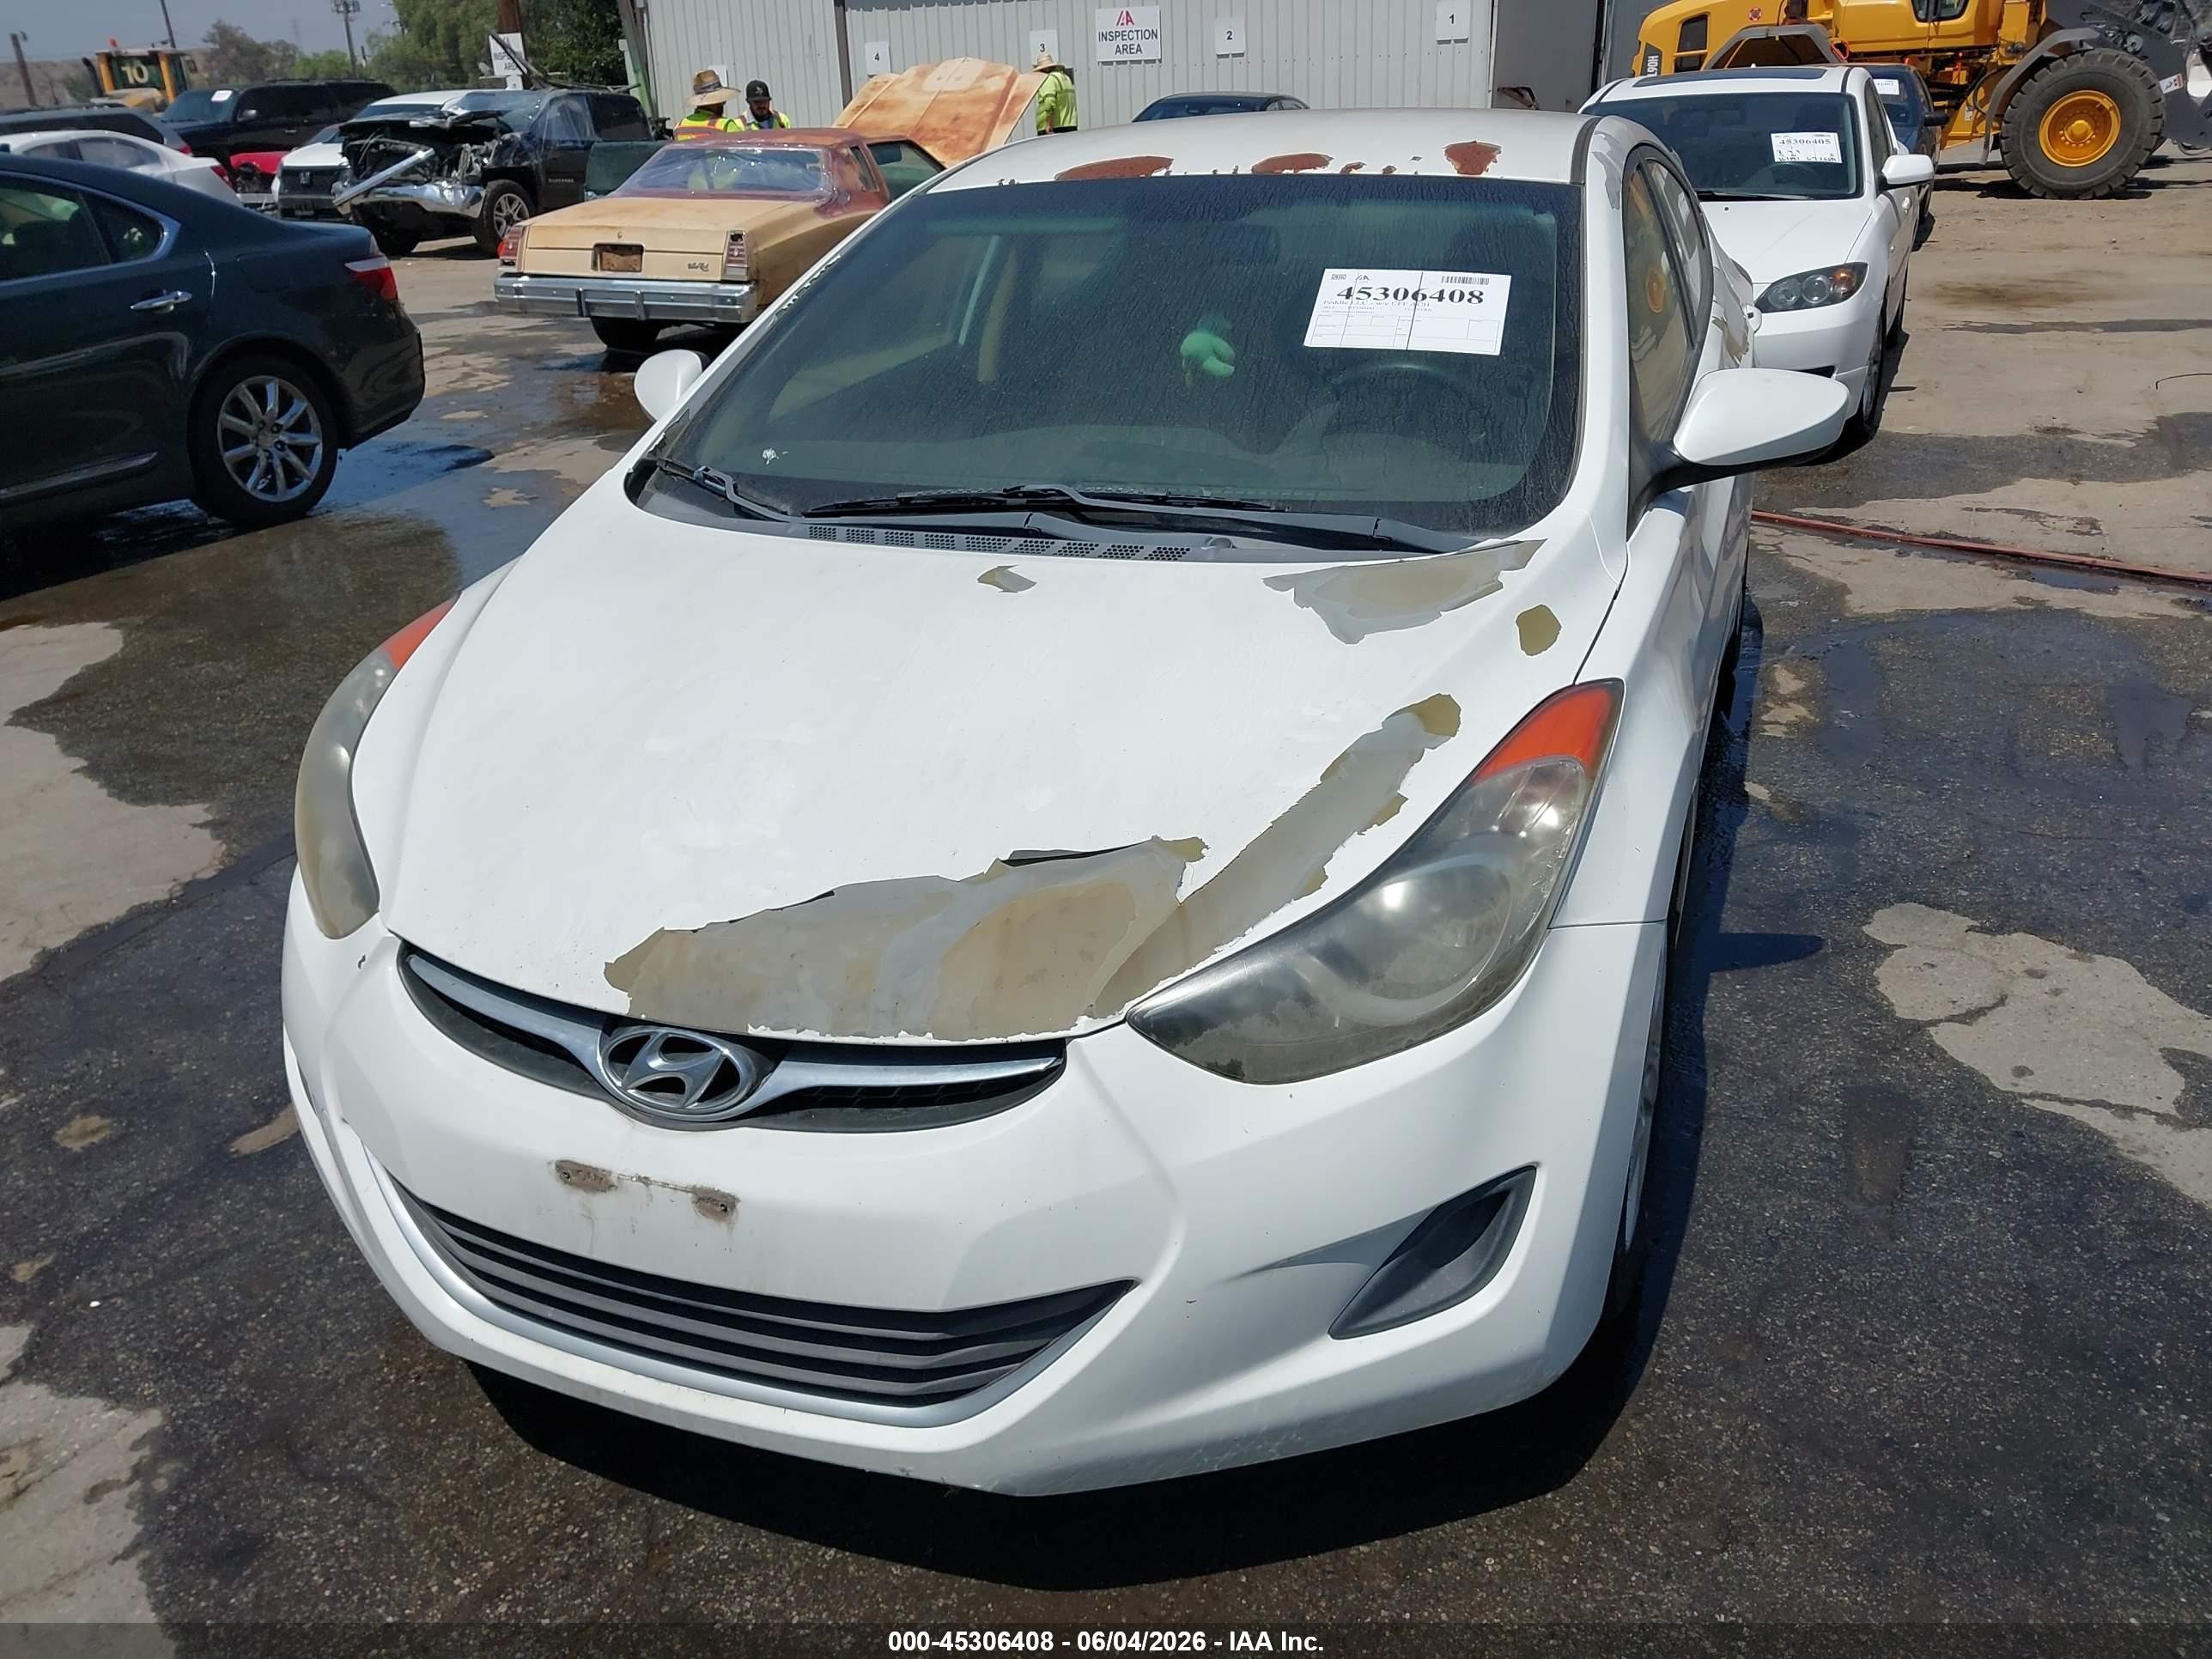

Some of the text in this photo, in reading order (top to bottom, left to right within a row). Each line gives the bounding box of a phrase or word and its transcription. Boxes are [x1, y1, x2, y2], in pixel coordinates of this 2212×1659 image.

[1449, 14, 1455, 24] 1
[1098, 28, 1158, 42] INSPECTION
[1225, 30, 1233, 40] 2
[1039, 43, 1046, 53] 3
[1115, 43, 1143, 56] AREA
[874, 52, 880, 61] 4
[121, 62, 149, 83] 10
[1336, 286, 1485, 305] 45306408
